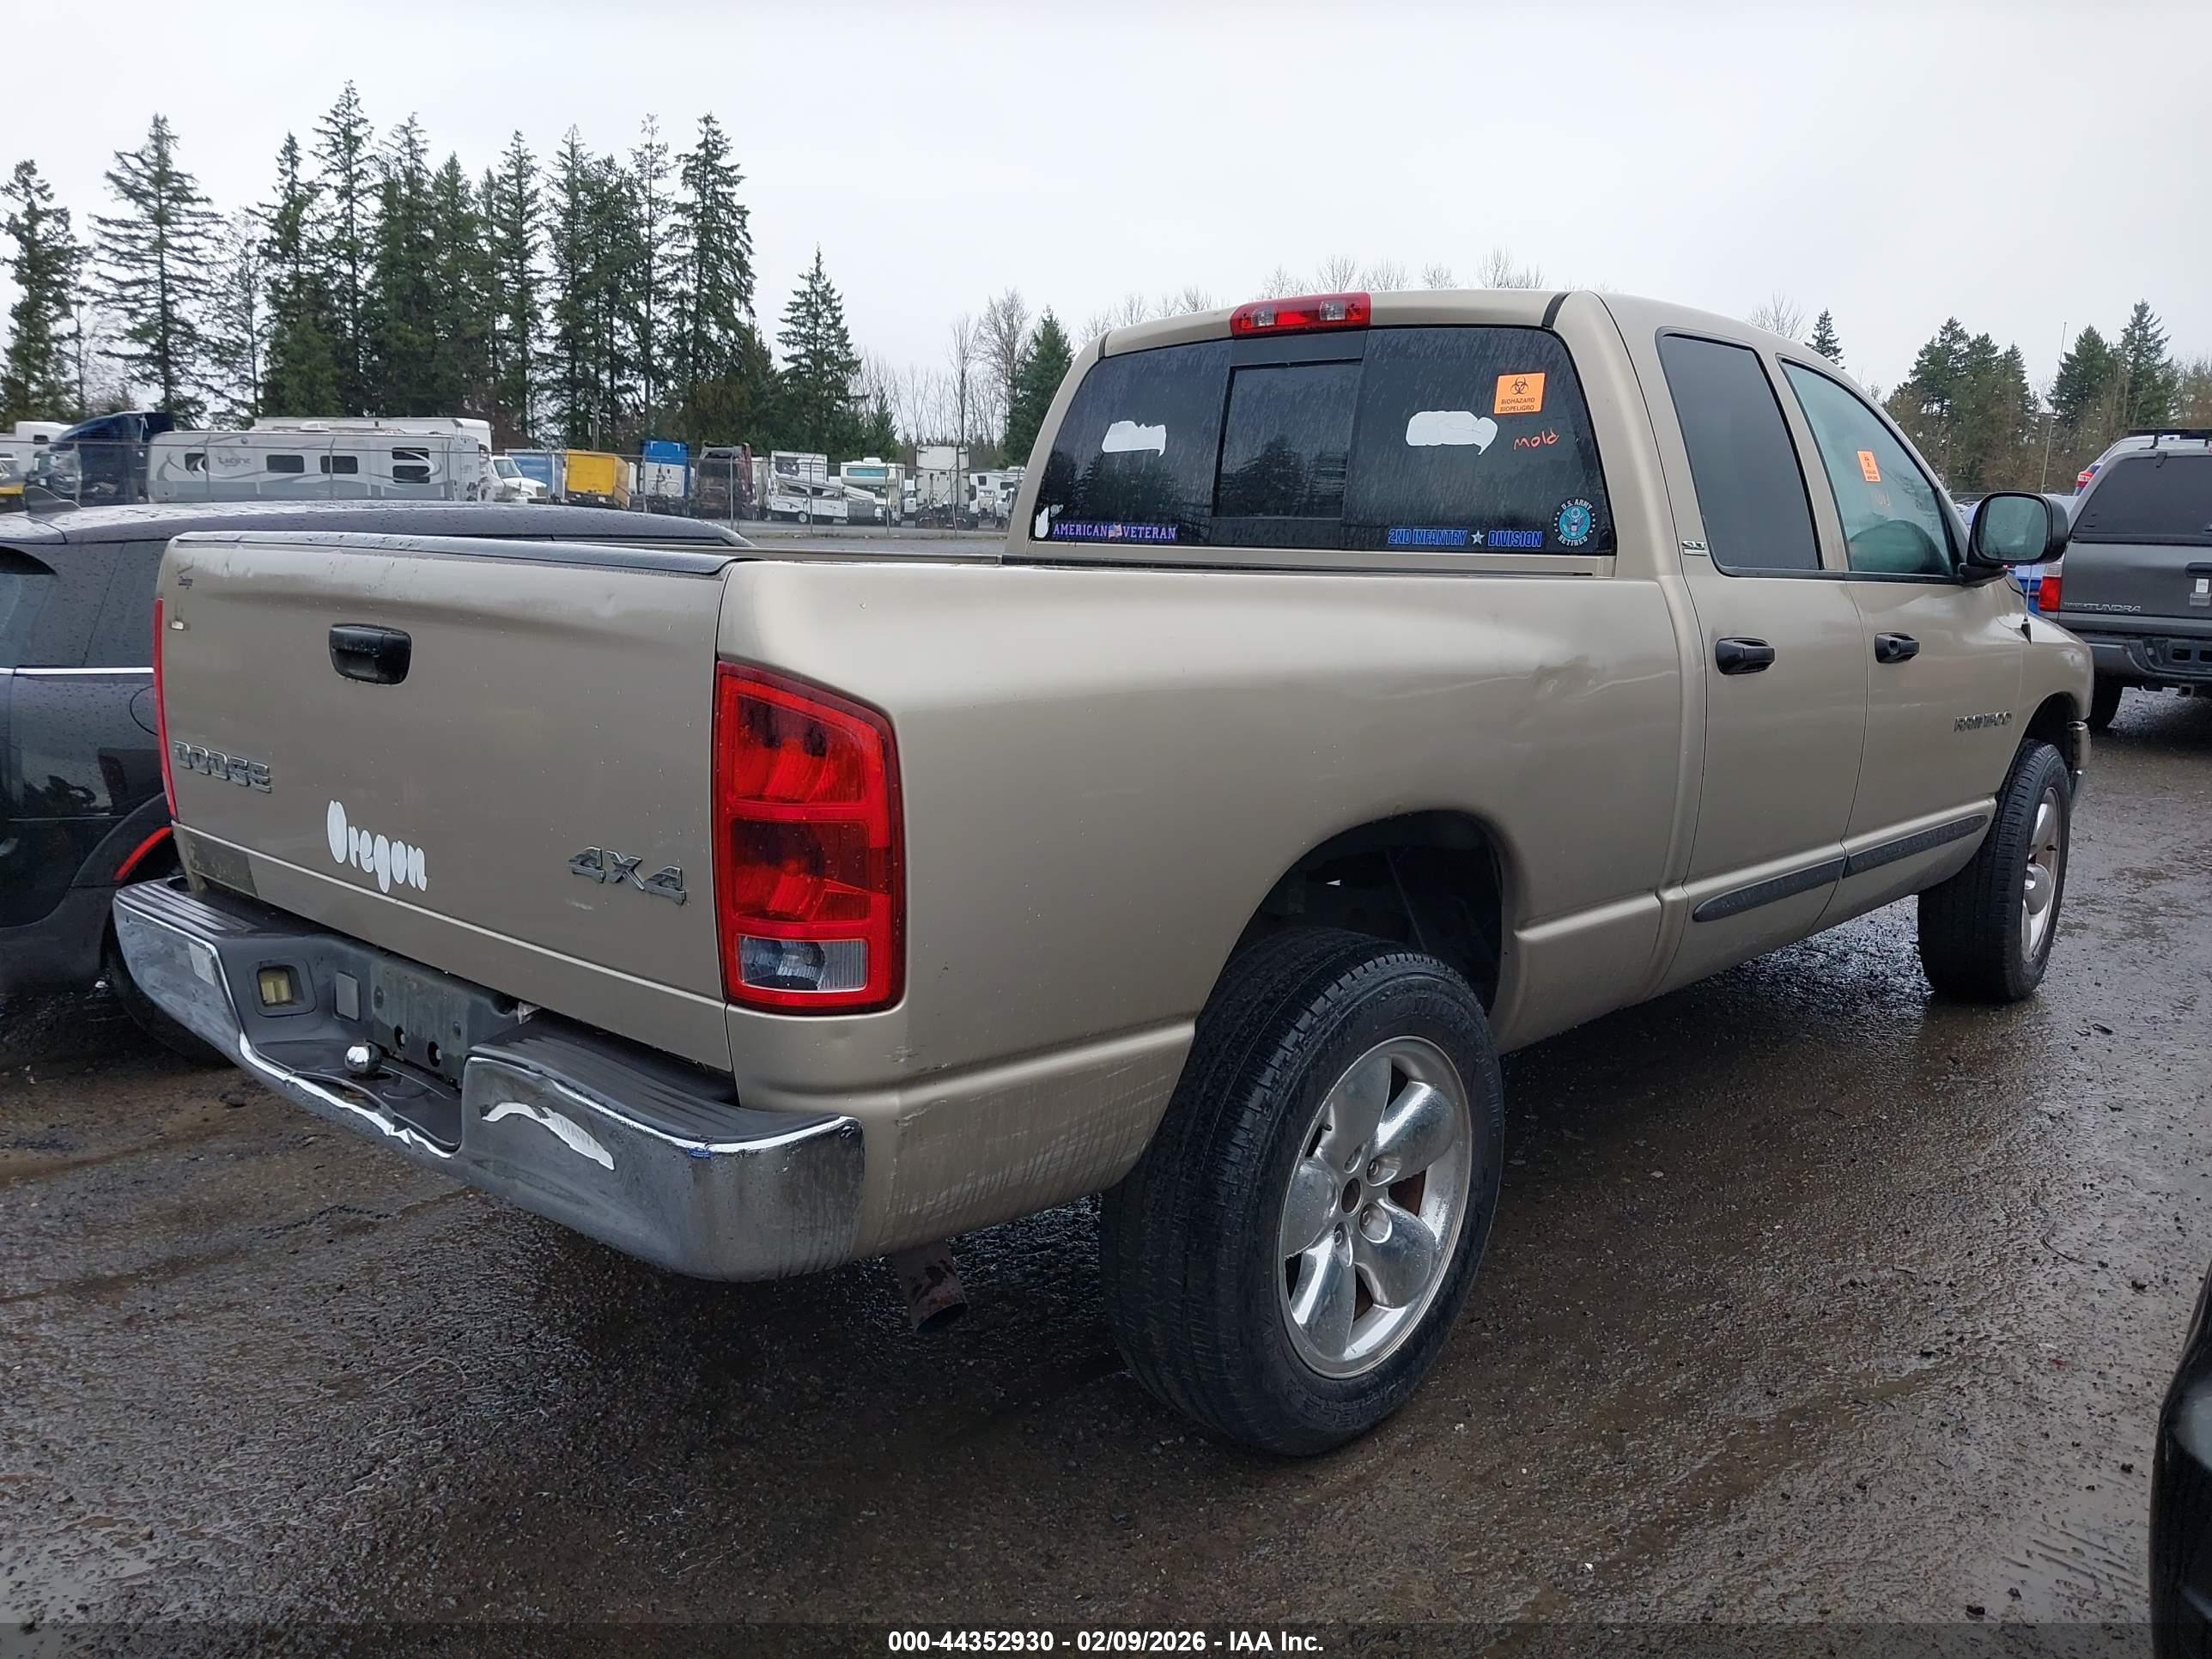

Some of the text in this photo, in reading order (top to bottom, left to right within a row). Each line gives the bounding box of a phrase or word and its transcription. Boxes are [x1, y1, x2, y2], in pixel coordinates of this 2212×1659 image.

[1574, 498, 1593, 511] ARMY
[1053, 523, 1176, 540] AMERICAN VETERAN
[1388, 528, 1543, 548] 2ND INFANTRY DIVISION
[1558, 533, 1589, 547] RETIRED
[2084, 603, 2142, 612] TUNDRA
[173, 740, 272, 793] DODGE
[327, 799, 428, 894] Oregon
